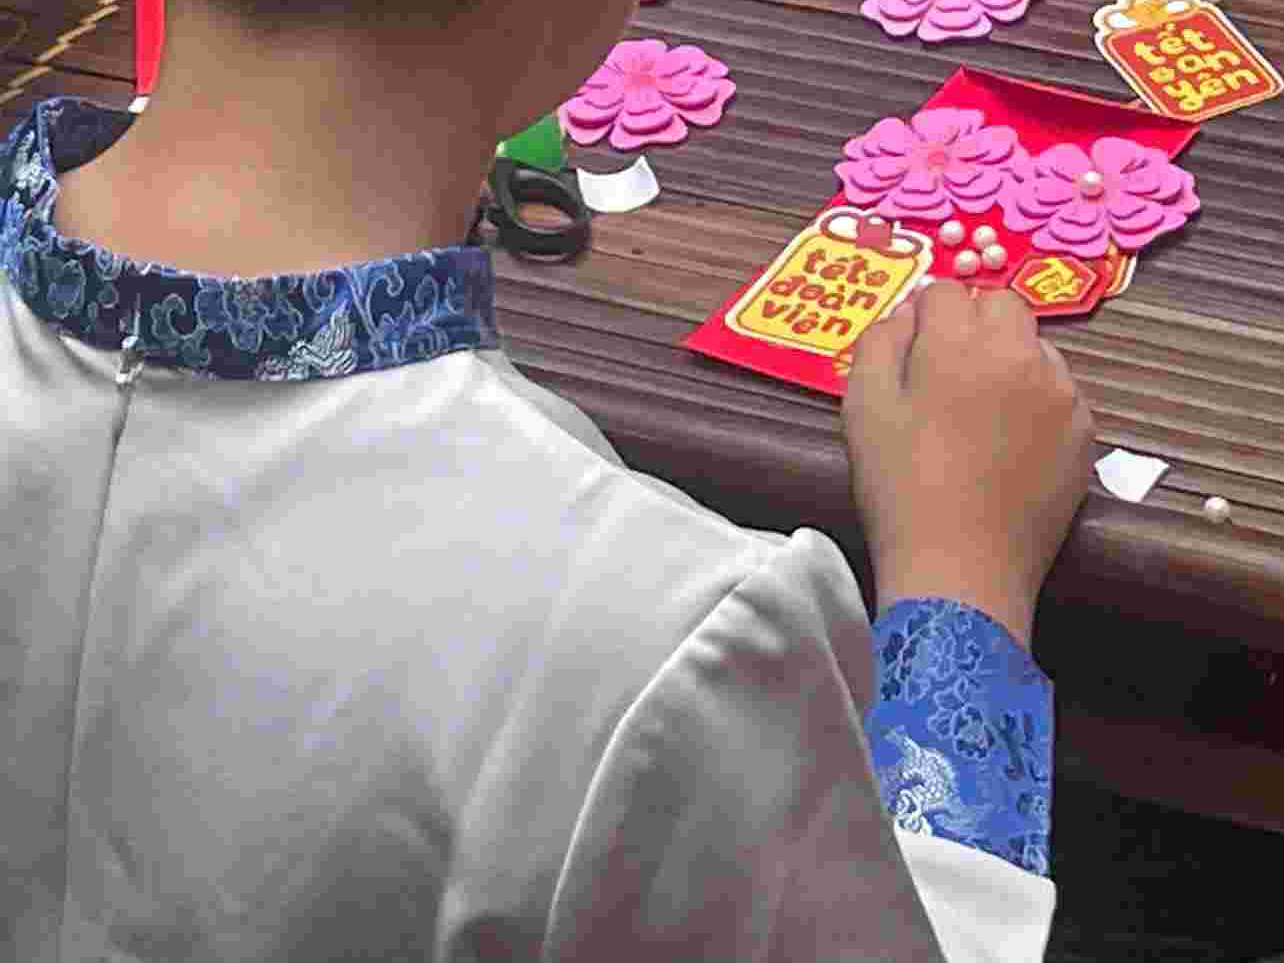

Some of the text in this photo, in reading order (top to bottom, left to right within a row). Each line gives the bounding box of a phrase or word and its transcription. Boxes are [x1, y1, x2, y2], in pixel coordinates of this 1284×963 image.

[1133, 22, 1216, 66] tết
[1176, 50, 1241, 74] an
[1163, 69, 1260, 111] yên
[768, 274, 879, 311] đoàn
[761, 300, 853, 337] viên
